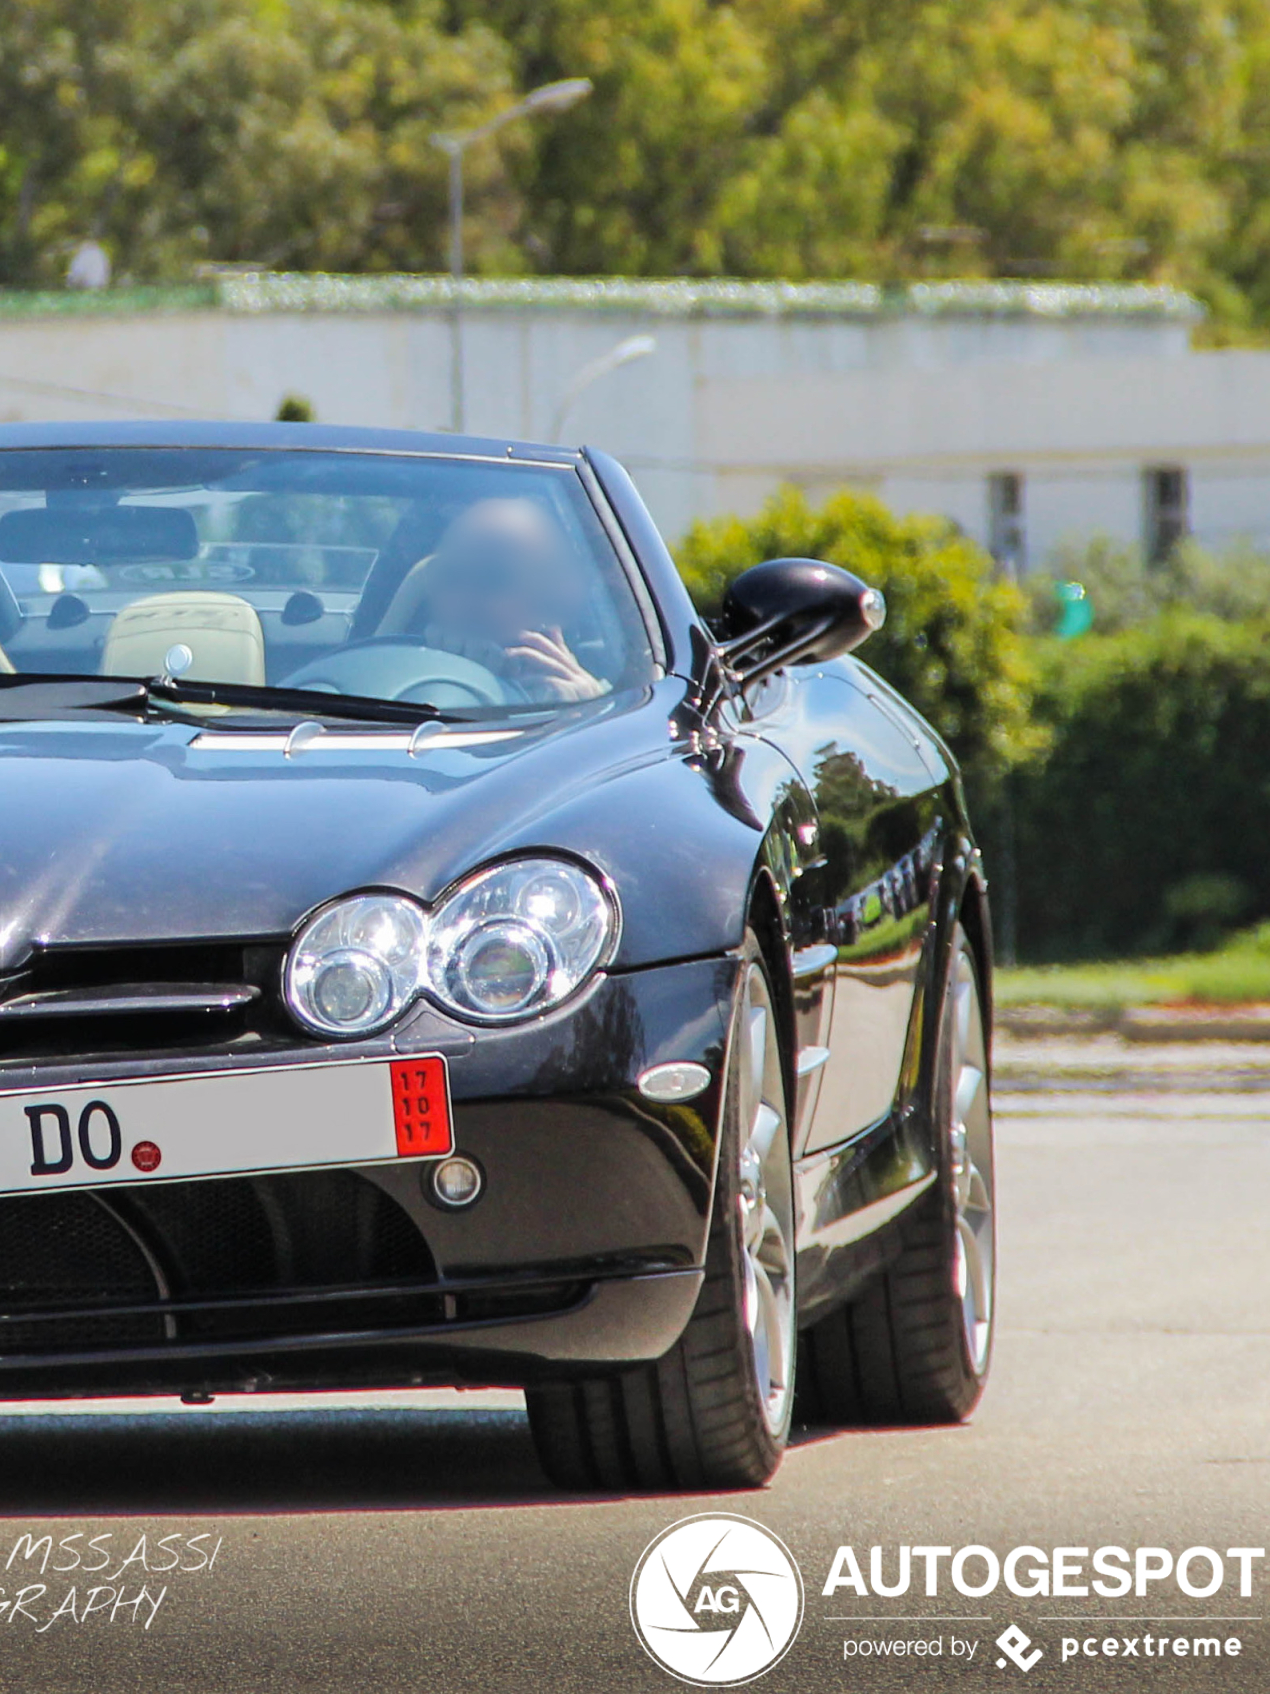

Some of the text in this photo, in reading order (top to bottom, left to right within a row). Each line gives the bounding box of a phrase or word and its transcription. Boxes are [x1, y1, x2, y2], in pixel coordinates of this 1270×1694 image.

[400, 1070, 426, 1090] 17
[402, 1097, 430, 1116] 10
[23, 1101, 122, 1175] DO
[404, 1121, 431, 1142] 17
